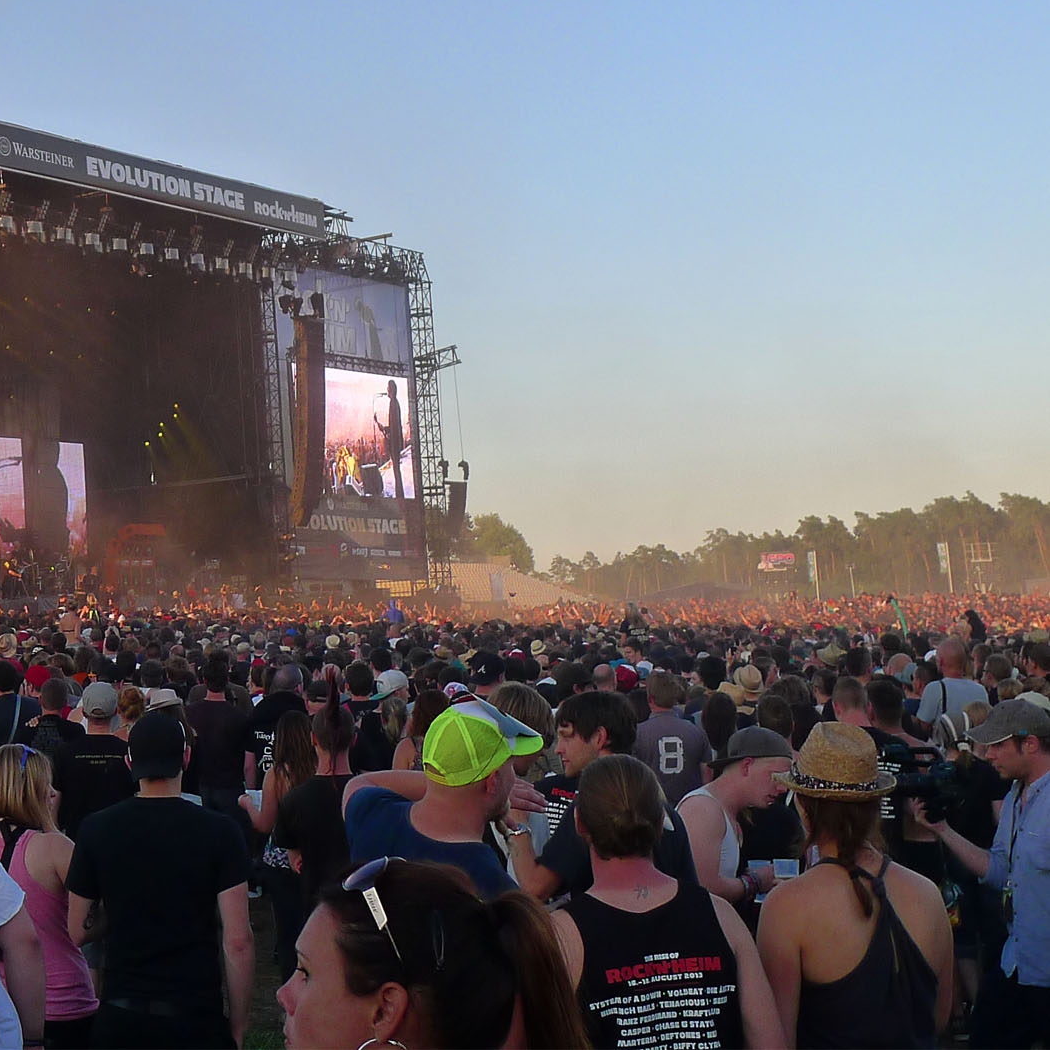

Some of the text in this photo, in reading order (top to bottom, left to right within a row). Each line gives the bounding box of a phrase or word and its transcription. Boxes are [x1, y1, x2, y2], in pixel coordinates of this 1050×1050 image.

[12, 141, 75, 168] WARSTEINER
[85, 155, 191, 198] EVOLUTION
[193, 183, 246, 211] STAGE
[367, 518, 407, 535] STAGE
[658, 736, 684, 775] 8
[650, 973, 683, 983] AUGUST
[589, 995, 622, 1011] SYSTEM
[622, 996, 632, 1004] OF
[633, 995, 640, 1003] A
[640, 990, 662, 1002] DOWN
[667, 988, 704, 998] VOLBEAT
[659, 999, 705, 1009] TENACIOUS
[616, 1017, 639, 1026] RANZ
[620, 1026, 651, 1037] CASPER
[654, 1021, 680, 1032] CHASE
[617, 1036, 657, 1047] MARTERIA
[660, 1031, 701, 1041] DEFTONES
[672, 1042, 697, 1050] BIFFY
